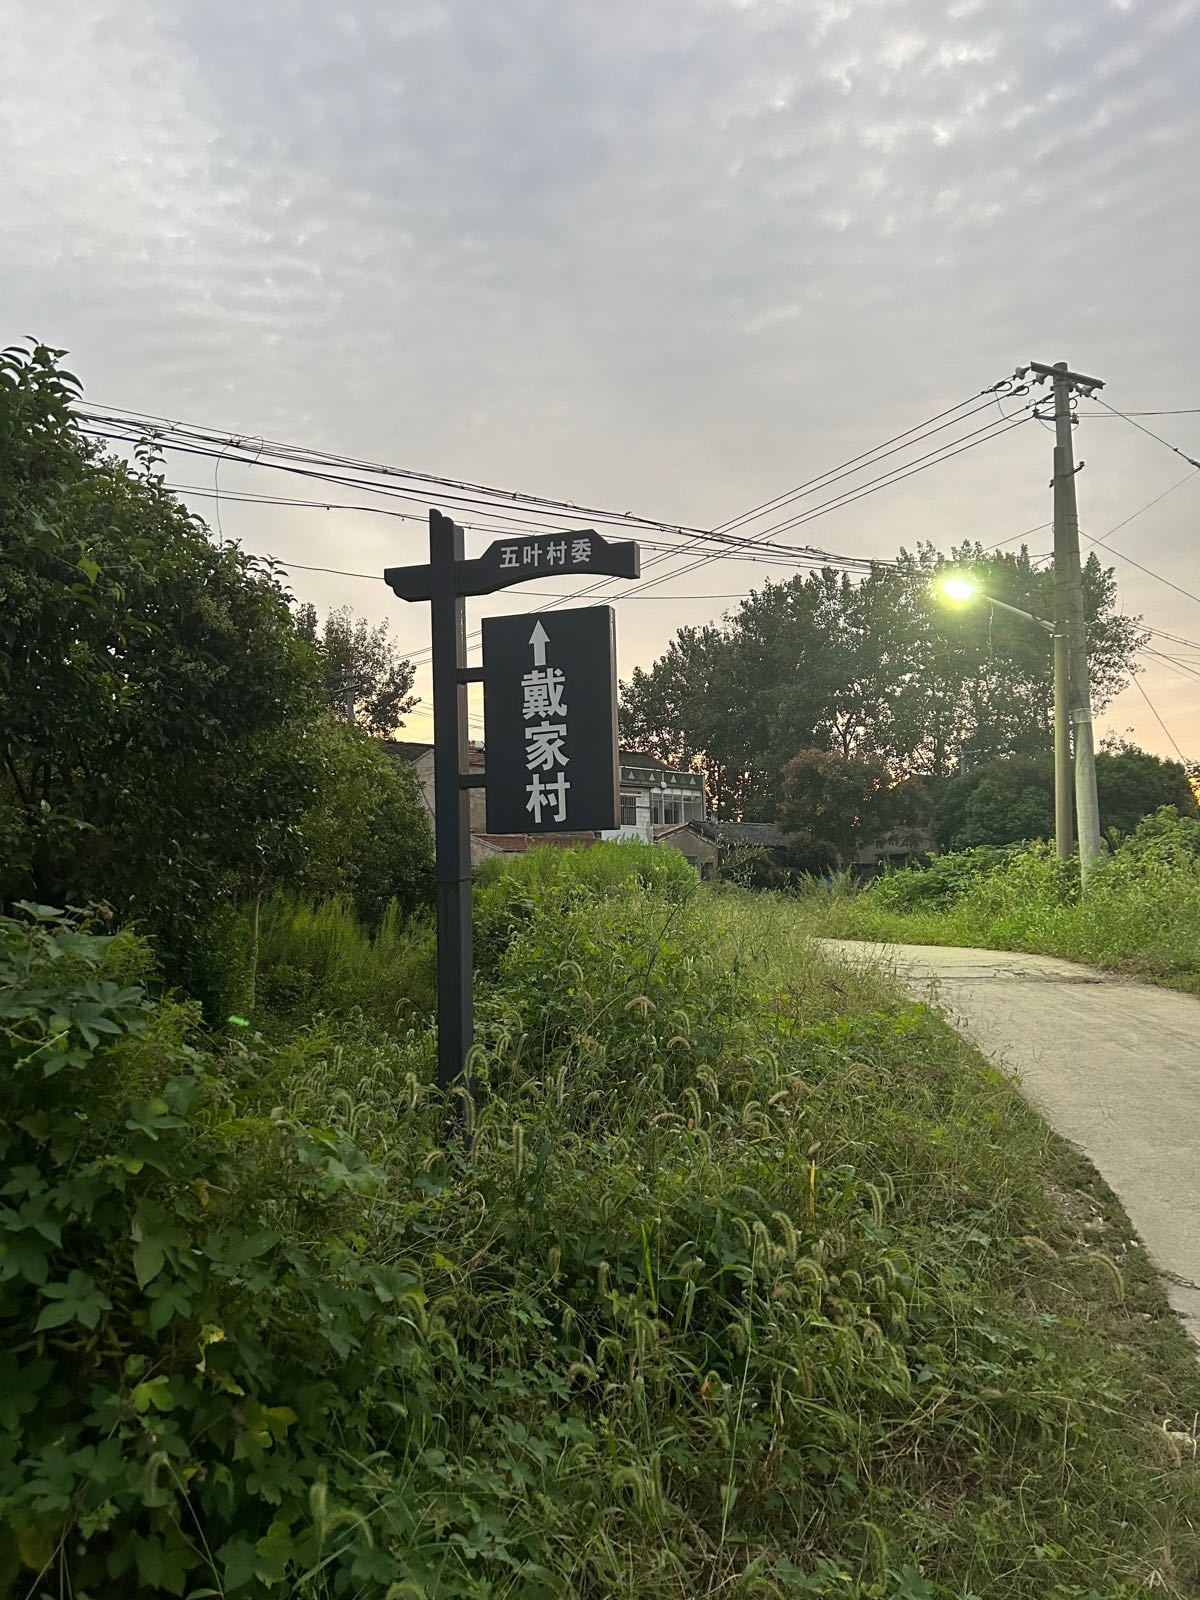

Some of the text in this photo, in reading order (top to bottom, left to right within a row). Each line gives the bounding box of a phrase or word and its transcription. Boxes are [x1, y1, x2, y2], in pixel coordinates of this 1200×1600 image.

[500, 538, 592, 568] 五叶村委
[521, 667, 571, 824] 戴家村
